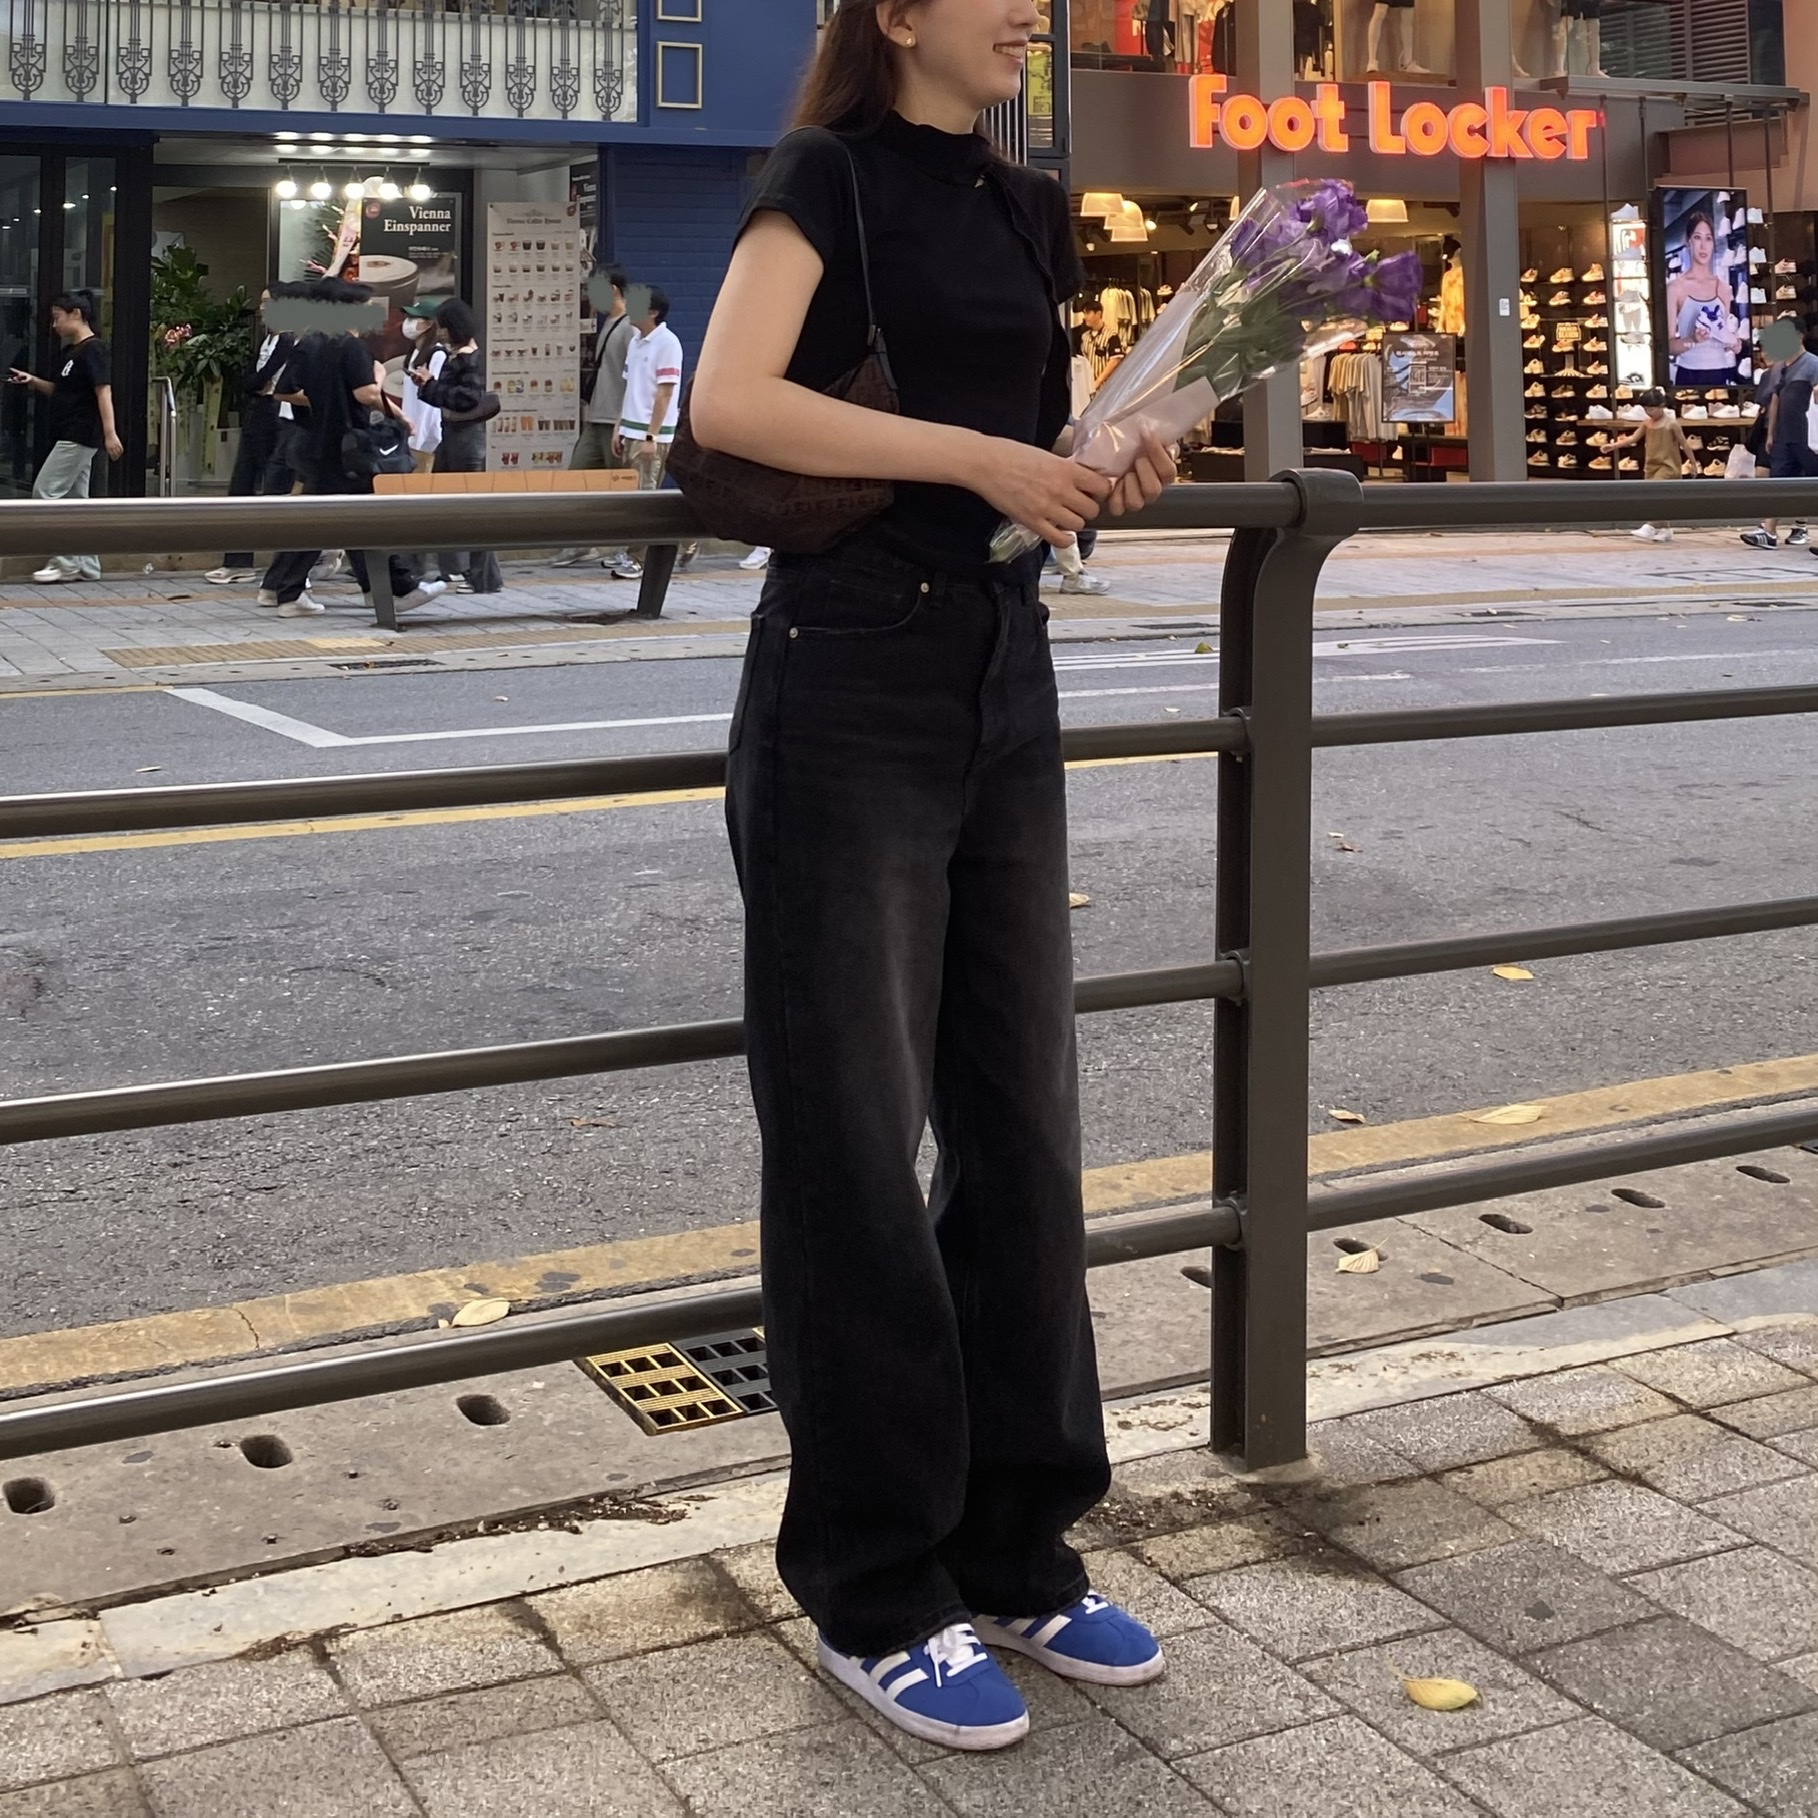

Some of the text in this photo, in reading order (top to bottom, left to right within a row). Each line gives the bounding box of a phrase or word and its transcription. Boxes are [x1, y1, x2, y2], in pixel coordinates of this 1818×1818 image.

[1189, 74, 1597, 160] Foot Locker
[409, 206, 451, 219] Vienna
[383, 219, 451, 236] Einspanner
